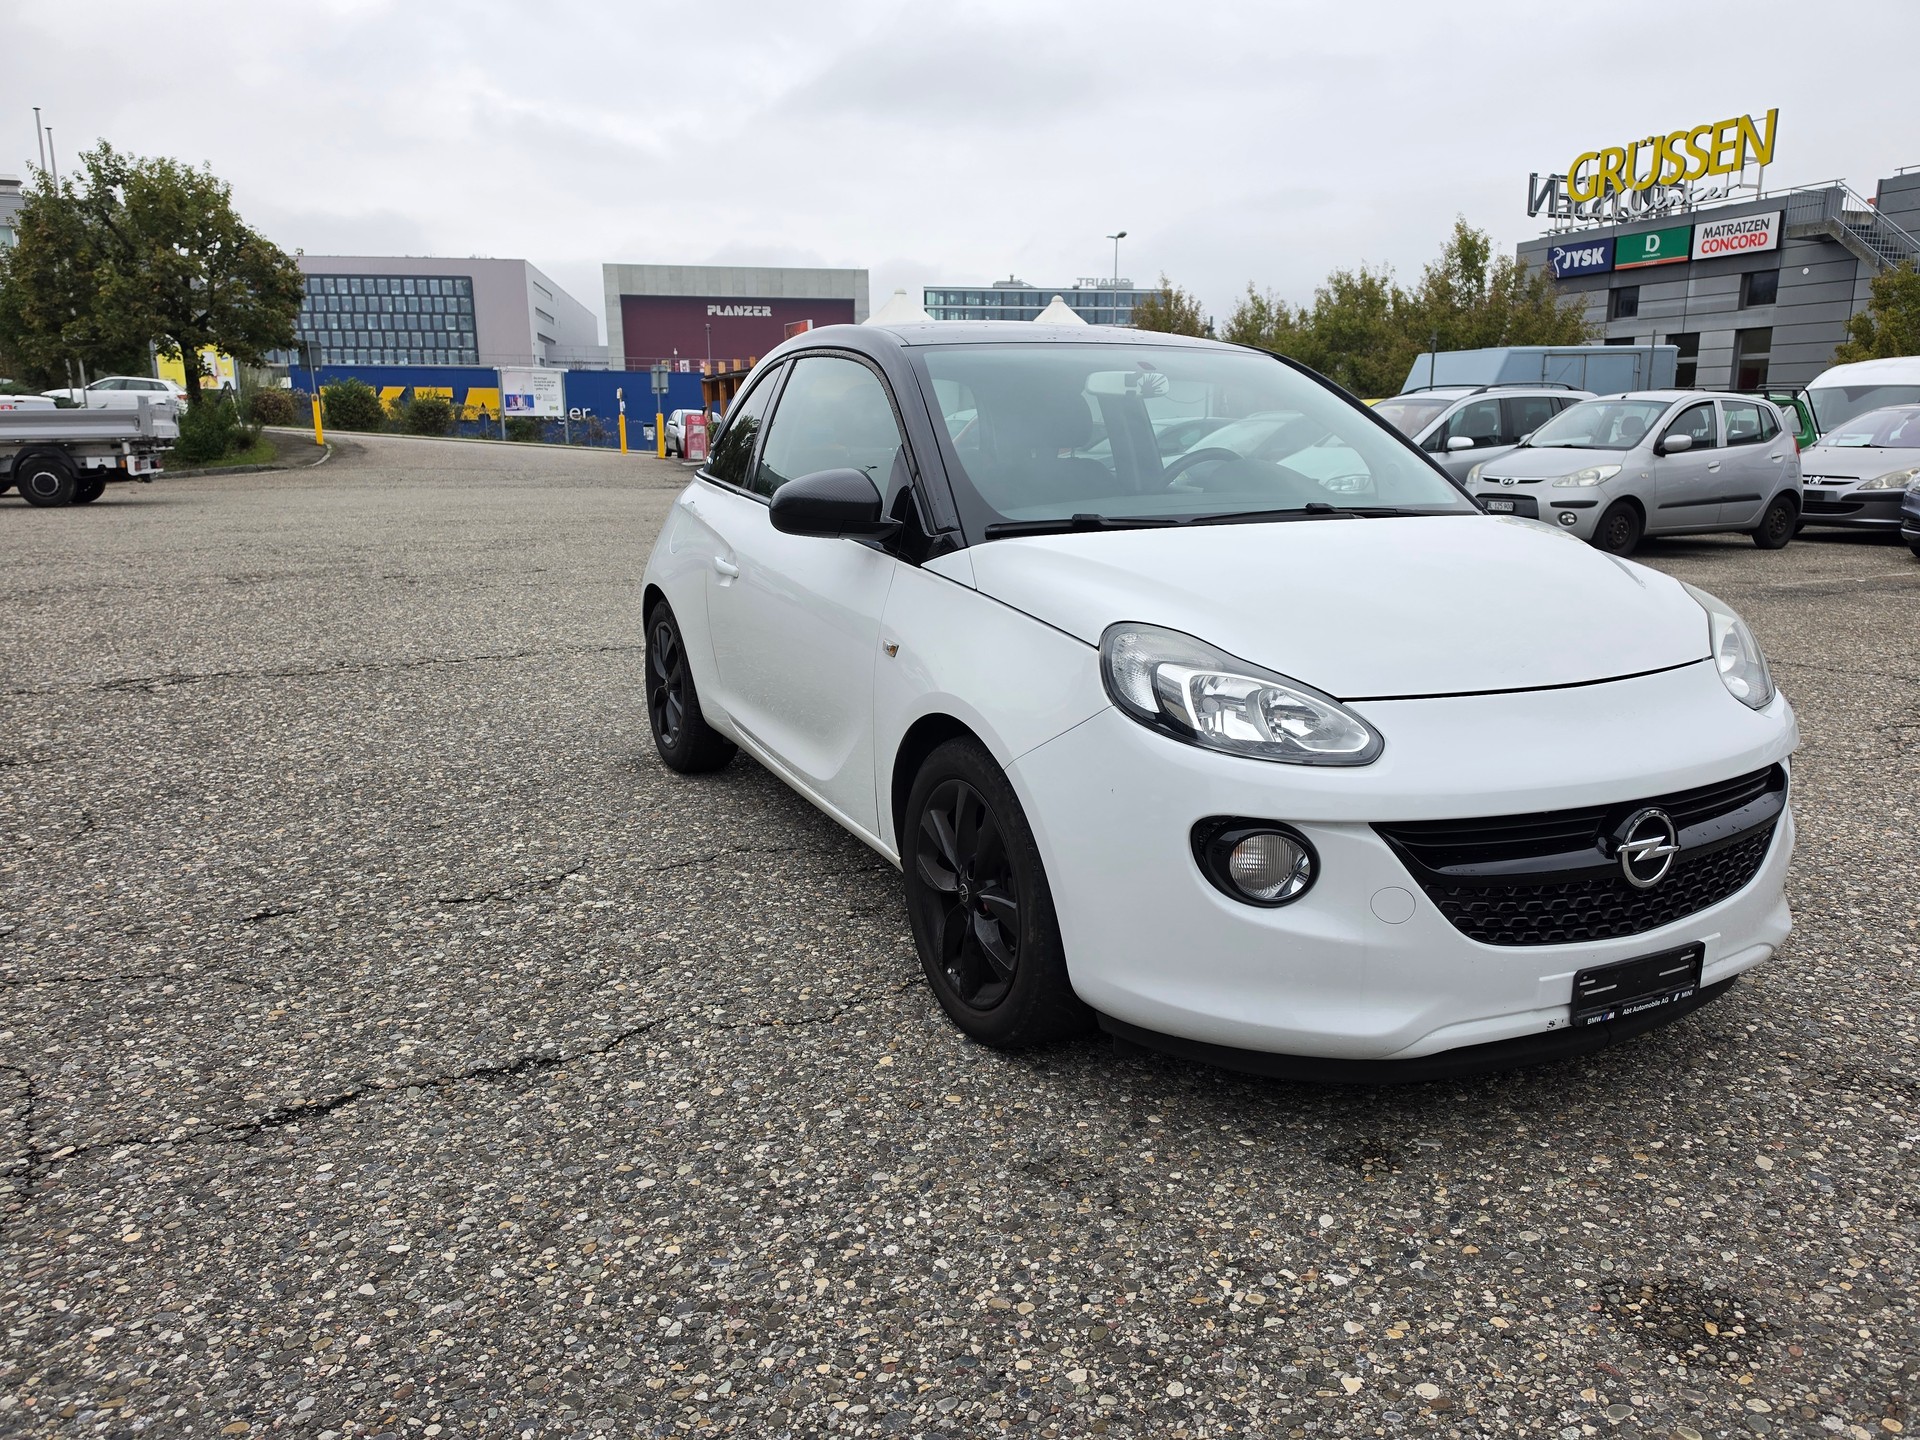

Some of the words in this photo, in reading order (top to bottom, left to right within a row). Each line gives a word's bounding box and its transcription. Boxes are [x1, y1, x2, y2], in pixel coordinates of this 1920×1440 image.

[1567, 108, 1779, 203] GRÜSSEN
[1628, 171, 1741, 217] Center
[1702, 217, 1771, 239] MATRATZEN
[1645, 234, 1660, 252] D
[1701, 231, 1768, 254] CONCORD
[1562, 246, 1605, 270] JYSK
[707, 305, 772, 317] PLANZER
[1681, 989, 1693, 999] MINI
[1622, 1008, 1632, 1016] Abt
[1632, 1000, 1661, 1013] Automobile
[1587, 1015, 1602, 1025] BMW
